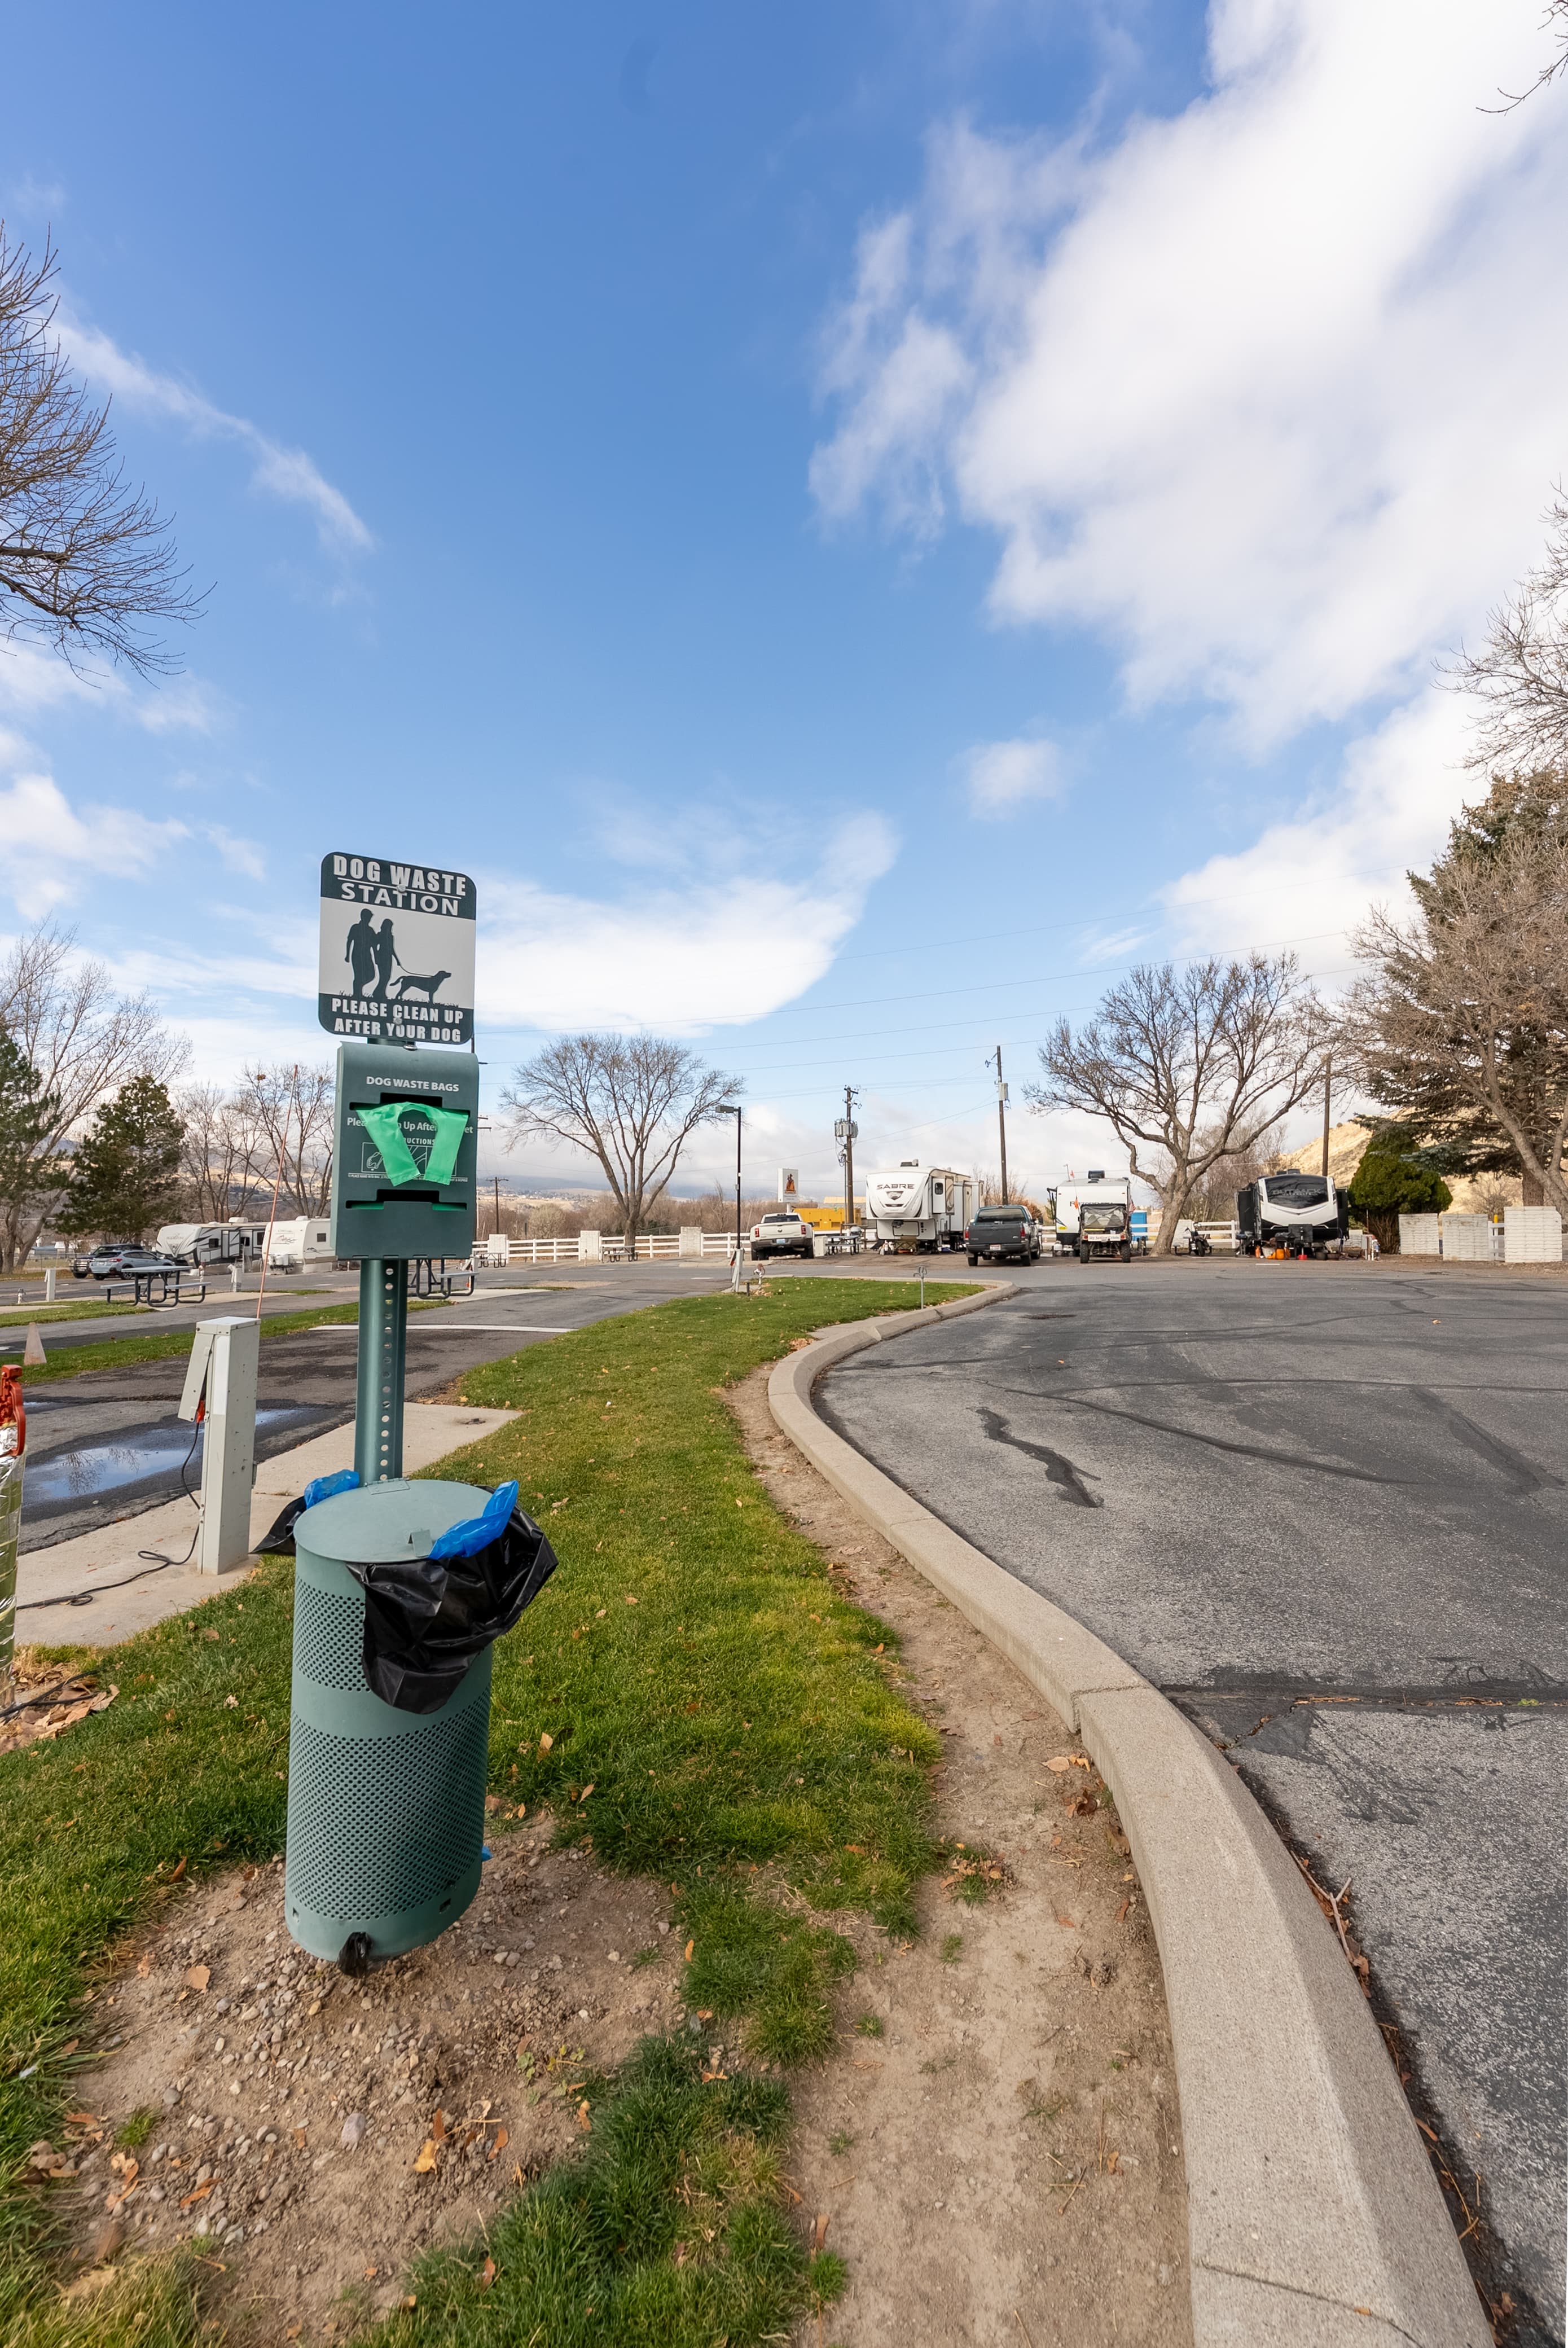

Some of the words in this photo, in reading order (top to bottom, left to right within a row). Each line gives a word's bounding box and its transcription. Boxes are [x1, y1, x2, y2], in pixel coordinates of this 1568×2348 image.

[333, 855, 380, 882] DOG
[390, 864, 466, 896] WASTE
[341, 883, 458, 916] STATION
[332, 998, 387, 1017] PLEASE
[393, 1004, 439, 1022] CLEAN
[445, 1010, 463, 1024] UP
[334, 1018, 381, 1035] AFTER
[386, 1022, 425, 1039] YOUR
[431, 1027, 461, 1042] DOG
[366, 1076, 392, 1086] DOG
[393, 1078, 429, 1090] WASTE
[431, 1082, 459, 1092] BAGS
[403, 1121, 415, 1132] Up
